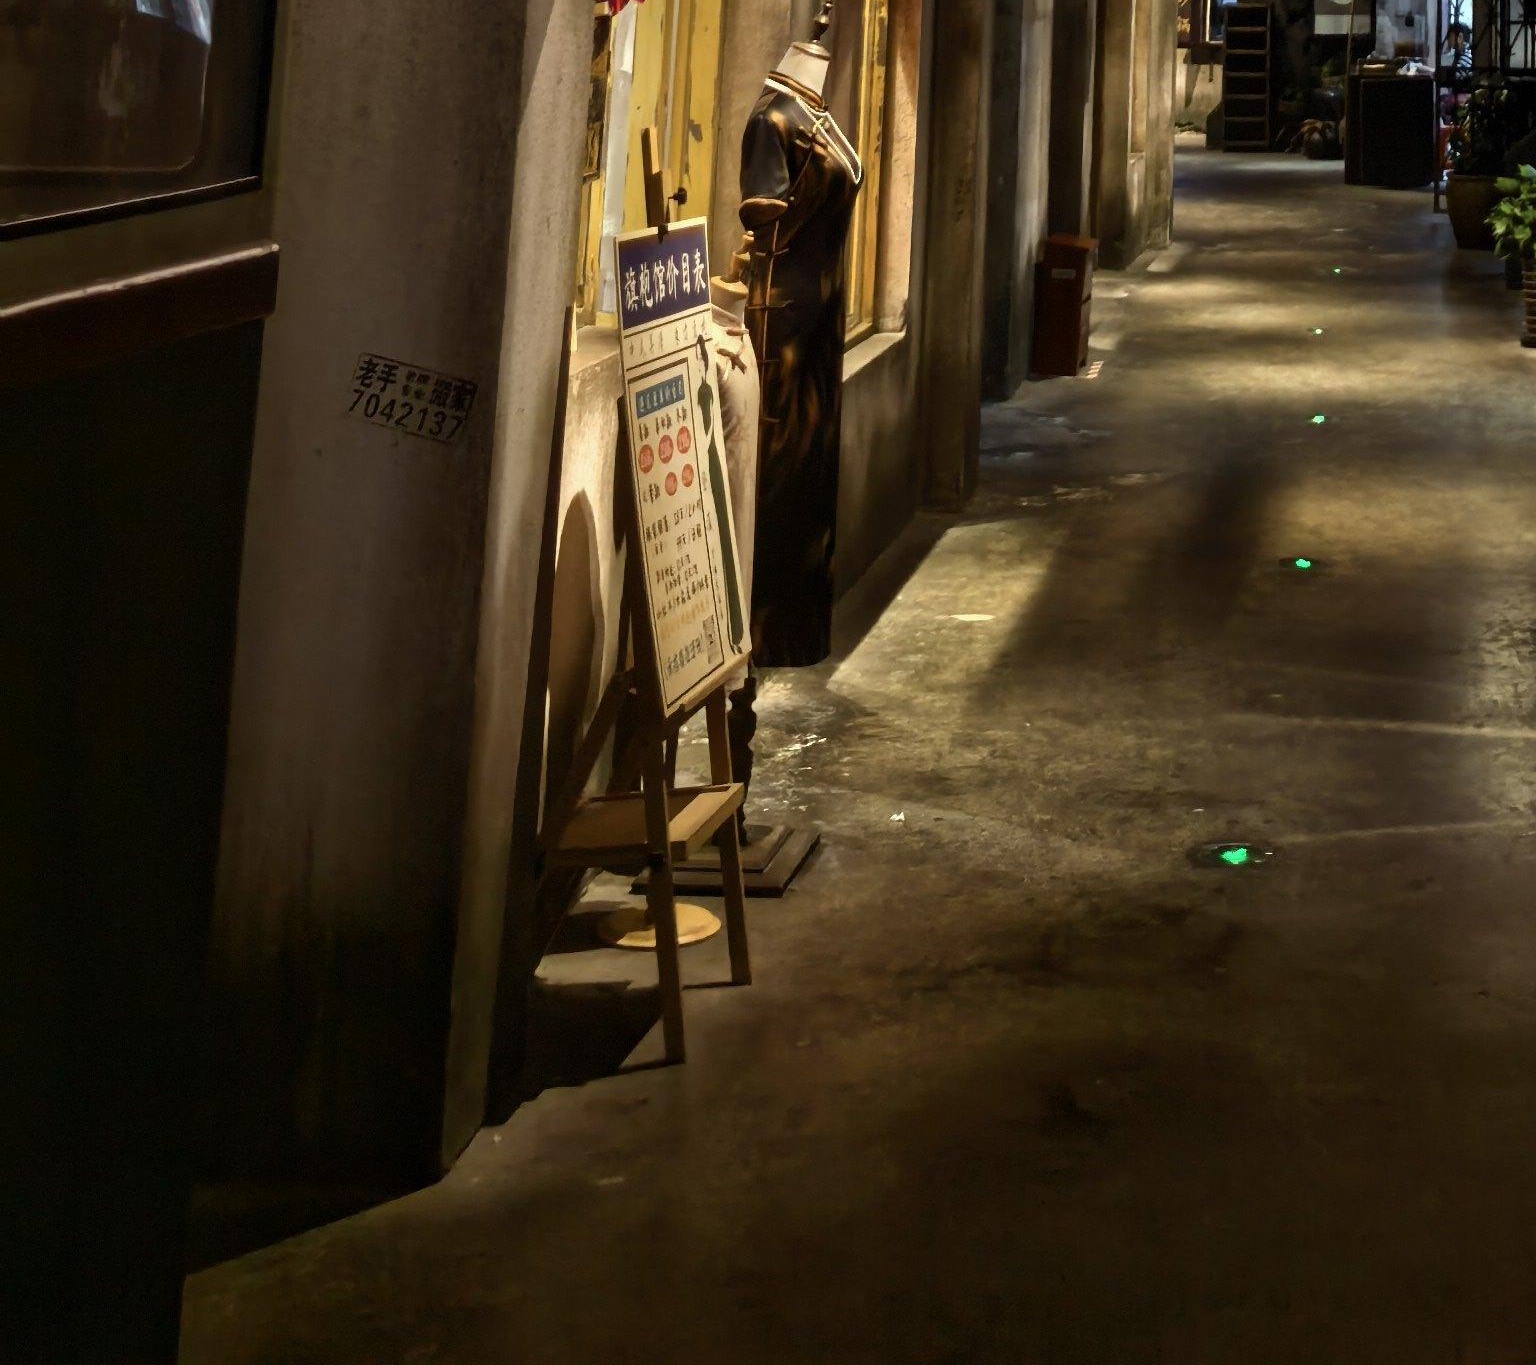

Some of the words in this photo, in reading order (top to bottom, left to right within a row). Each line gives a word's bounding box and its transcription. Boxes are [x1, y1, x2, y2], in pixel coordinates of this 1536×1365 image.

[624, 247, 706, 312] 旗袍馆价目表
[348, 388, 463, 441] 7042137
